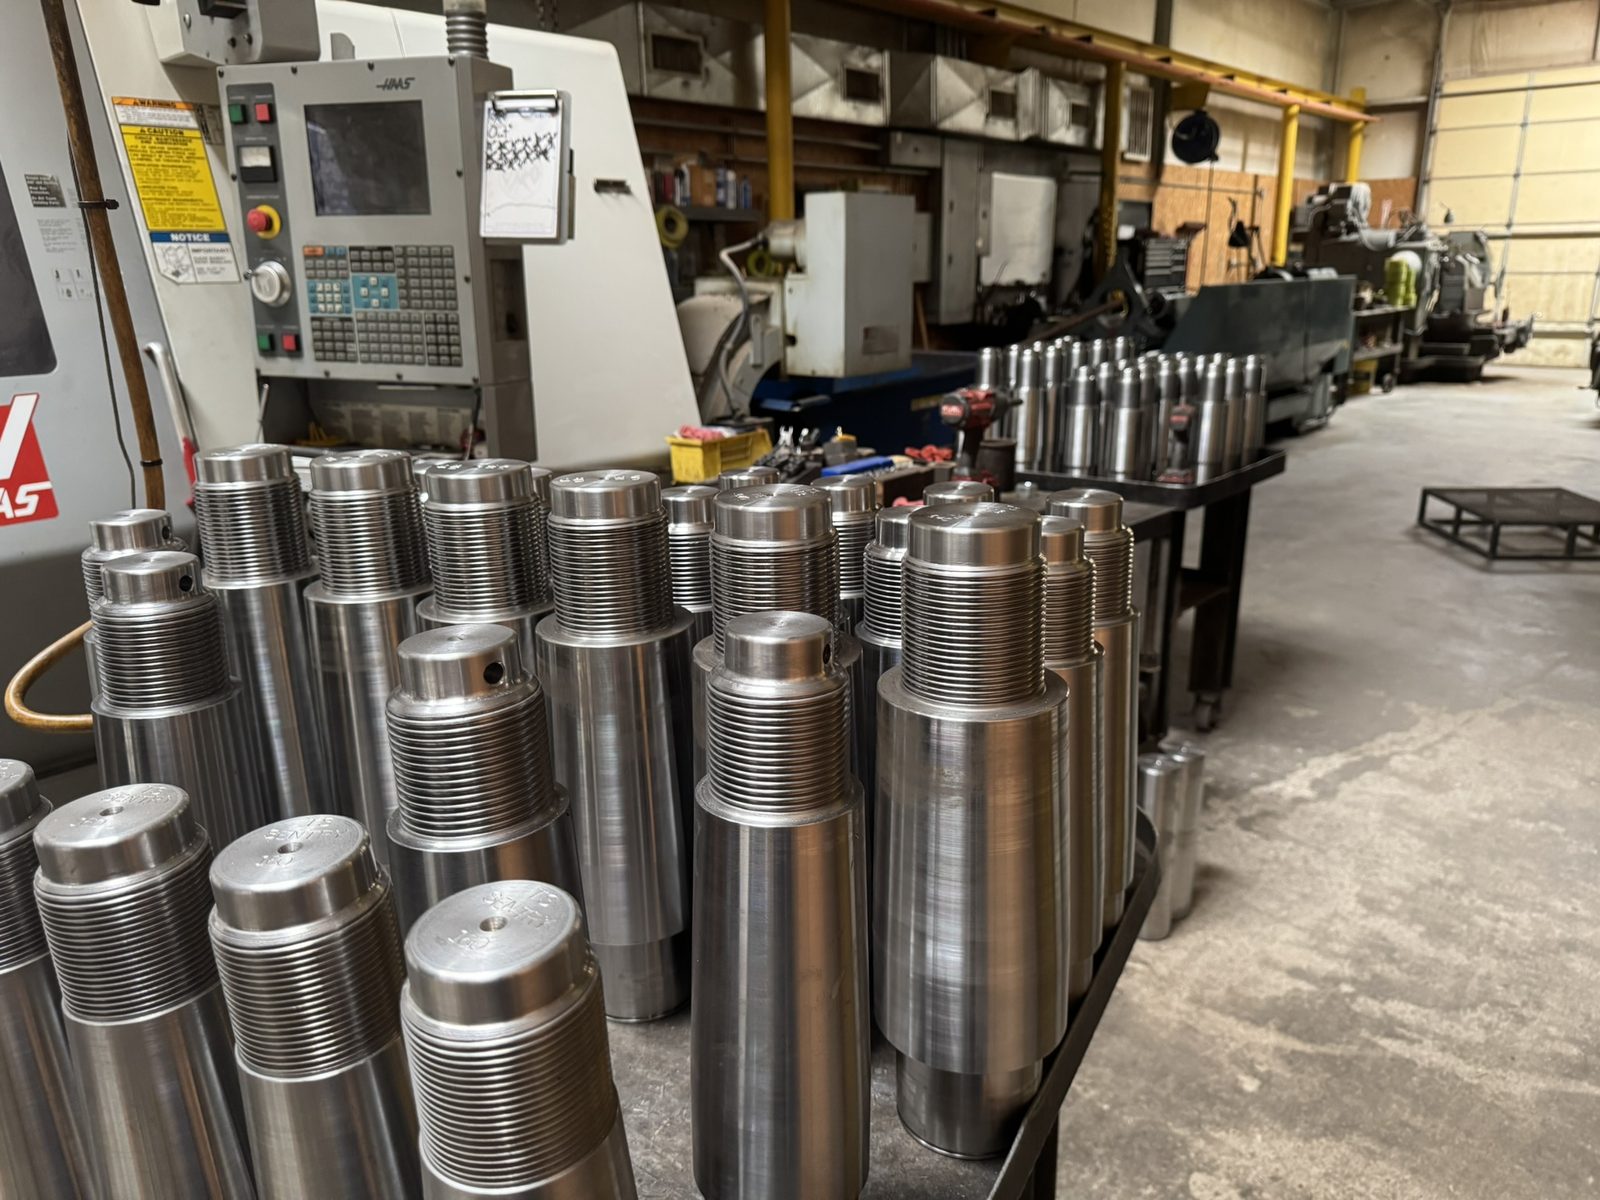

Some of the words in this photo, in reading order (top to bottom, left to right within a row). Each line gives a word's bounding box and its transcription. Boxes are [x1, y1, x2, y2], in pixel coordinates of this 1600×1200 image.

[376, 77, 415, 91] HAAS
[147, 127, 184, 136] CAUTION
[170, 232, 211, 242] NOTICE
